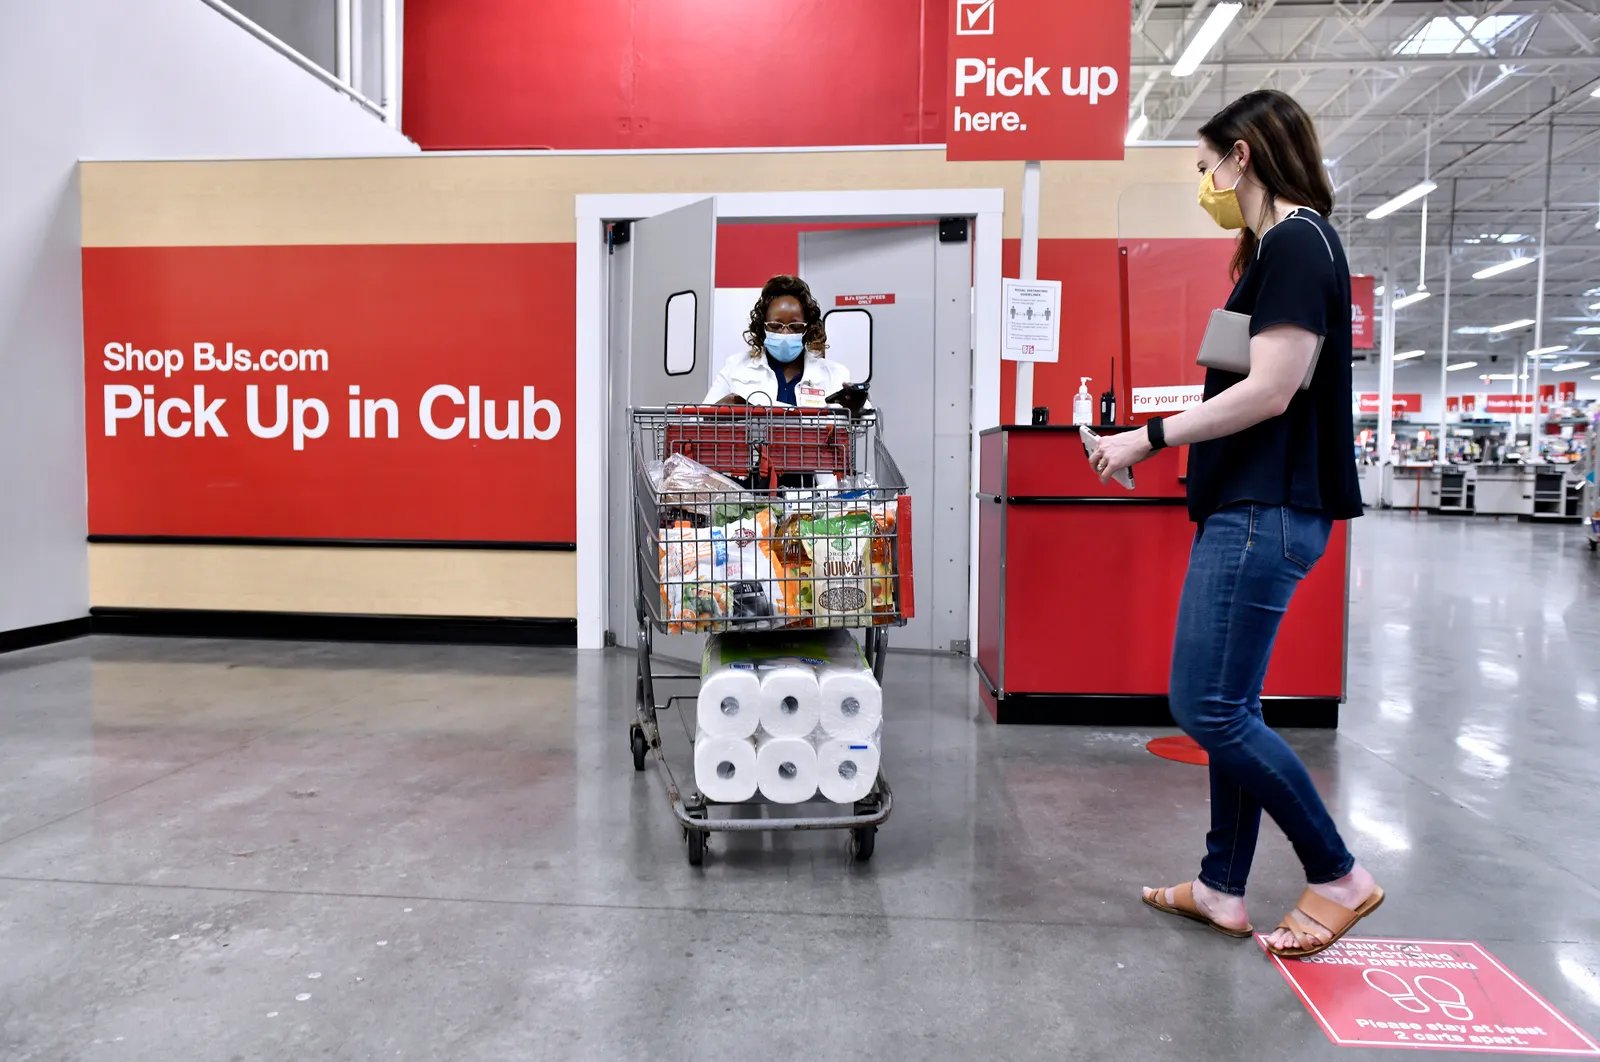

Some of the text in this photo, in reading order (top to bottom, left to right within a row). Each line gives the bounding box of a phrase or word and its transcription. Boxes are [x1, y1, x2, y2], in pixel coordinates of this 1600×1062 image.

[955, 57, 1119, 105] Pick up
[954, 106, 1027, 132] here.
[103, 342, 329, 378] Shop BJs.com
[1133, 394, 1152, 404] For
[1154, 394, 1179, 405] your
[103, 384, 561, 451] Pick Up in Club
[823, 560, 863, 576] QUINOA
[1317, 949, 1455, 961] OR PRACTICING
[1331, 942, 1422, 952] HANK YOU
[1300, 956, 1479, 970] SOCIAL DISTANCING
[1355, 1018, 1547, 1035] Please stay at least
[1394, 1030, 1529, 1045] 2 carts apart.
